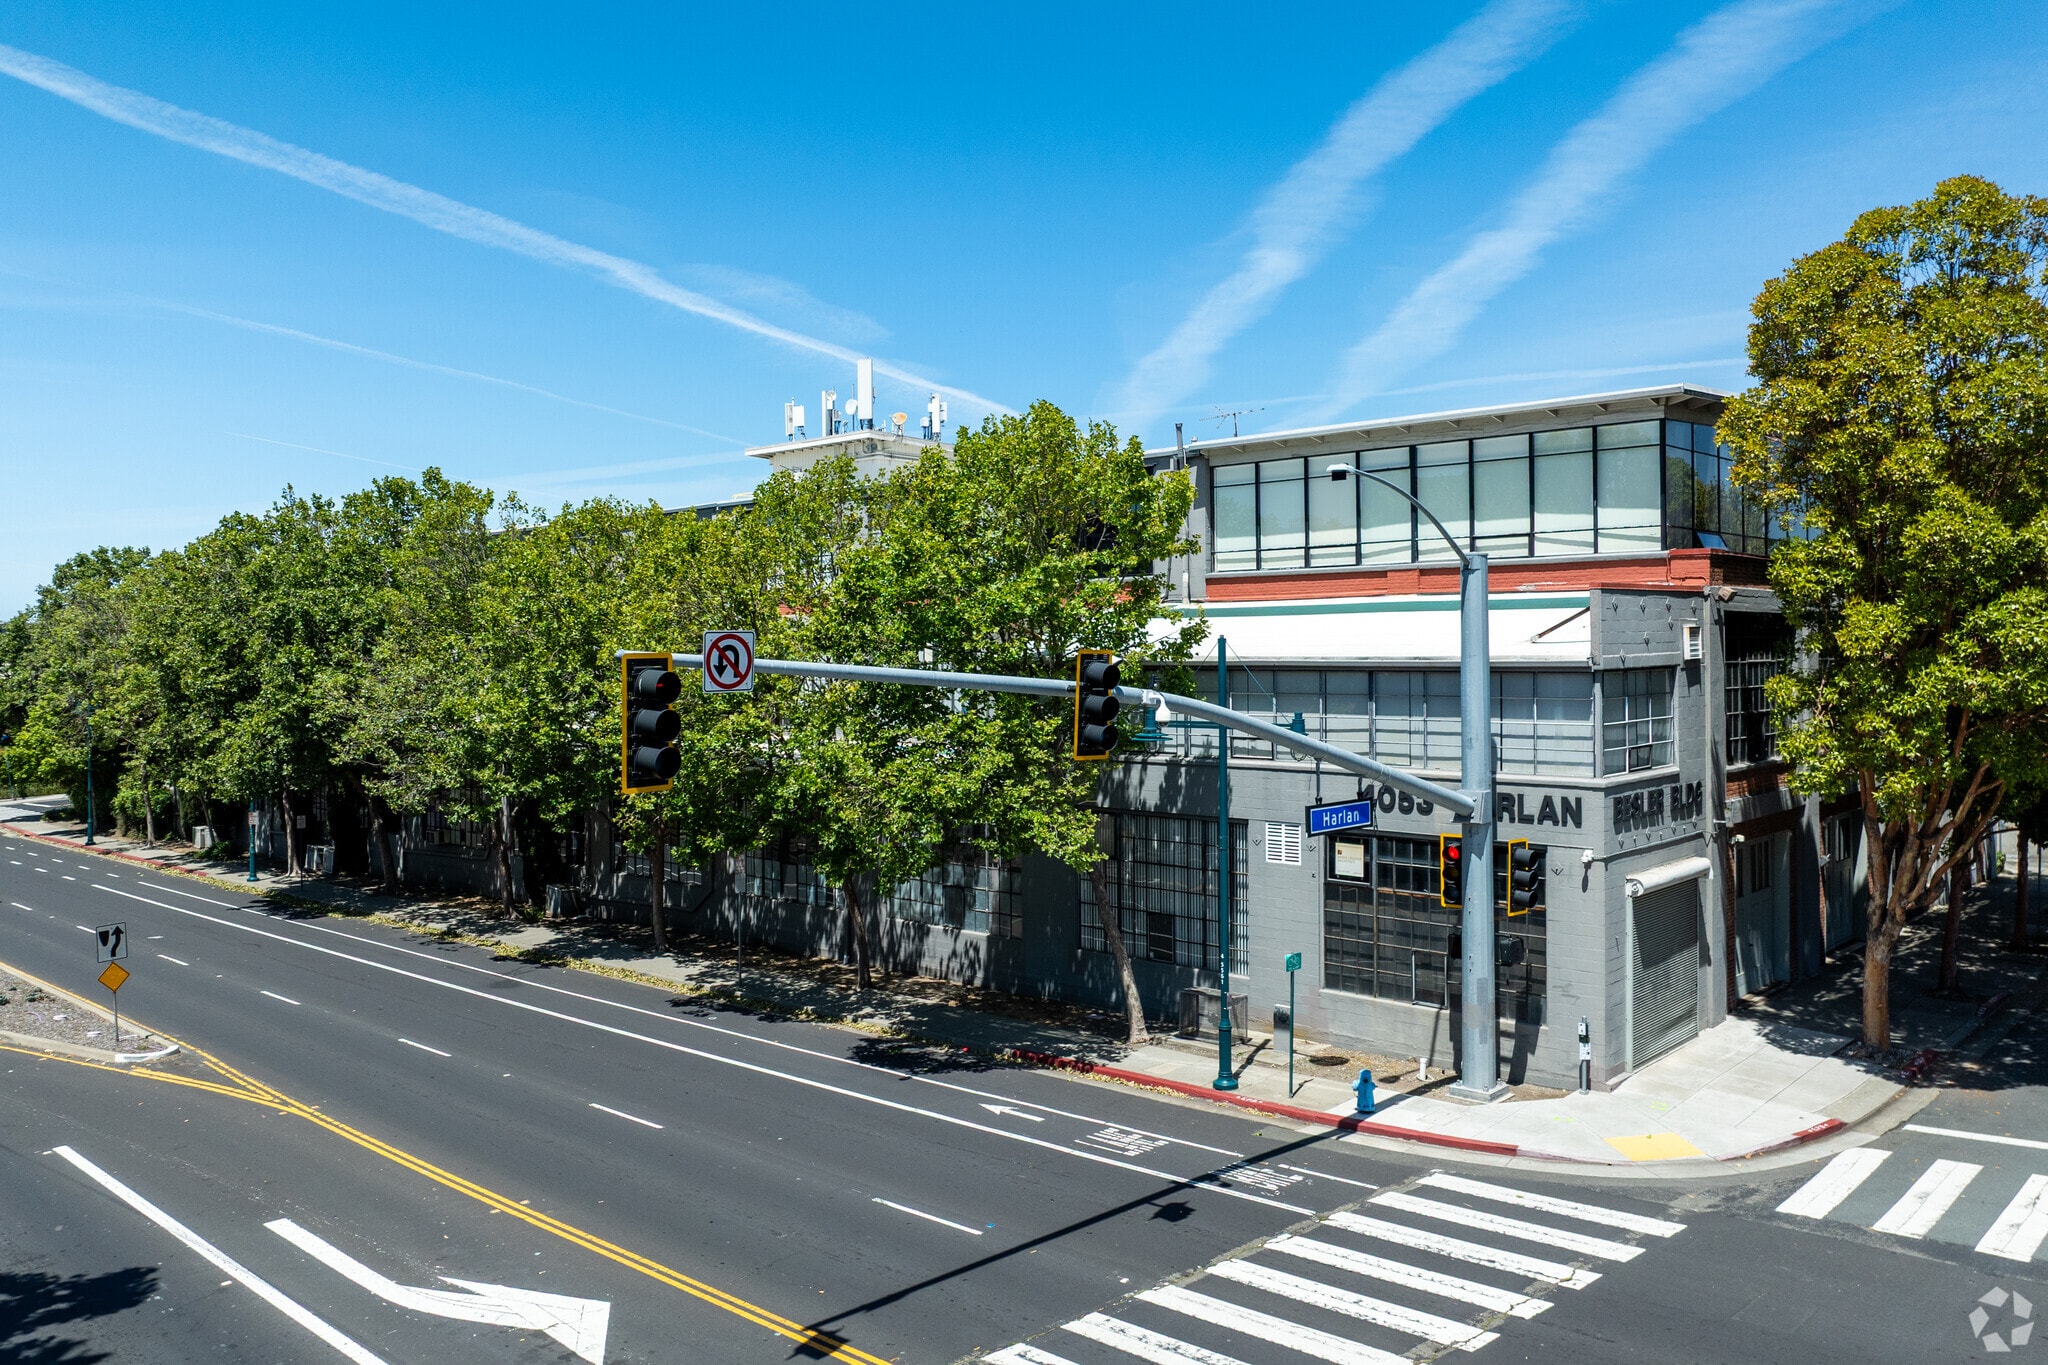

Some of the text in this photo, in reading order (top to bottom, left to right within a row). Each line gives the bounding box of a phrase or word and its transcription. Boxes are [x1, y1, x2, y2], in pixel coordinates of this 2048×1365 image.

[1613, 780, 1702, 824] BESLER BLDG
[1322, 809, 1360, 827] Harlan
